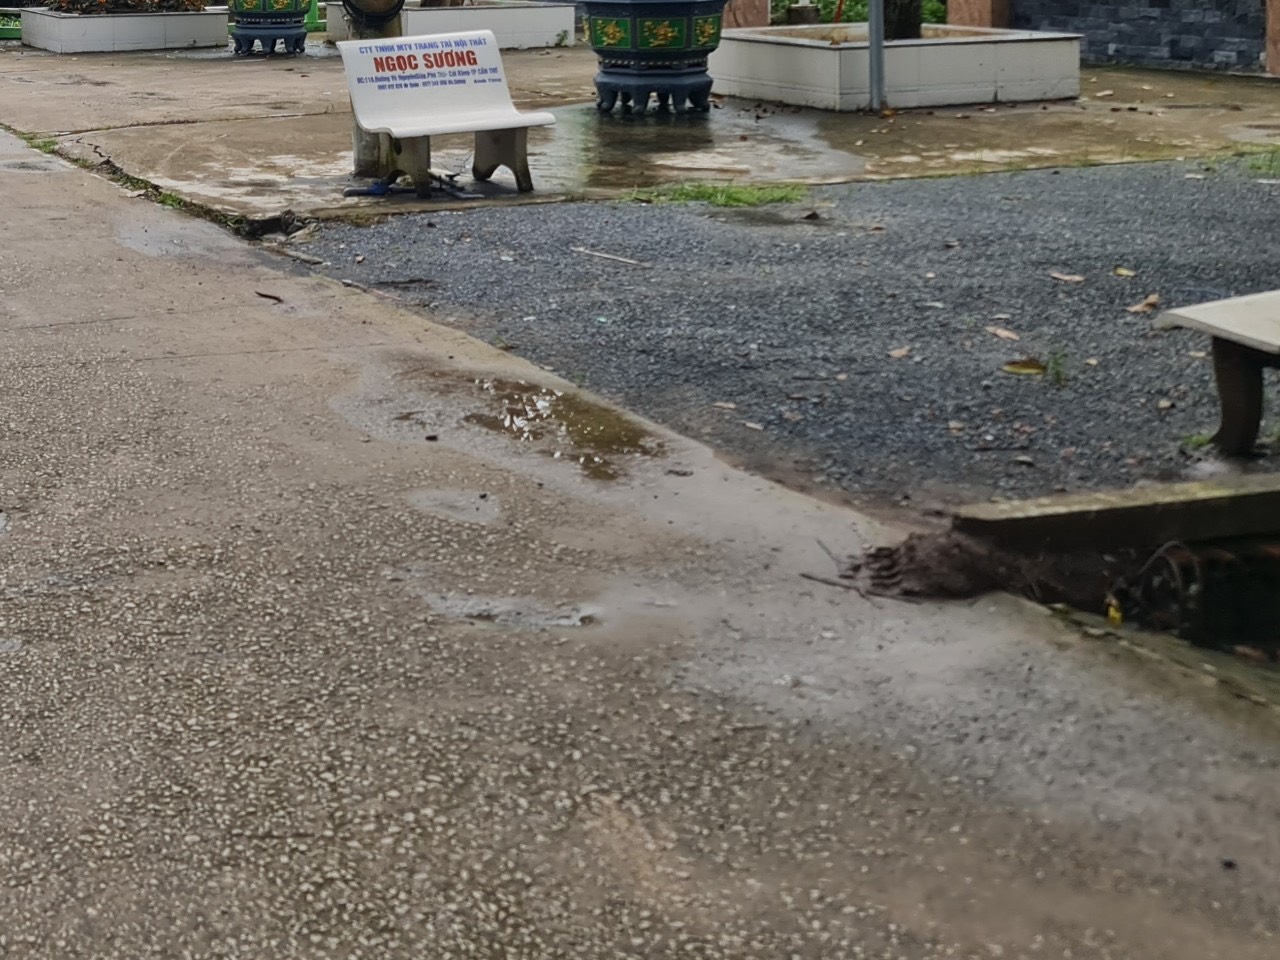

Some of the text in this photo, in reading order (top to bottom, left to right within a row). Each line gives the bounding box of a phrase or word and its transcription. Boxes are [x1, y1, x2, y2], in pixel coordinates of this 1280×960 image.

[359, 46, 373, 54] CTY
[374, 45, 396, 53] TNHH
[396, 43, 412, 51] MTV
[414, 42, 439, 50] TRANG
[373, 49, 478, 74] NGỌC SƯƠNG
